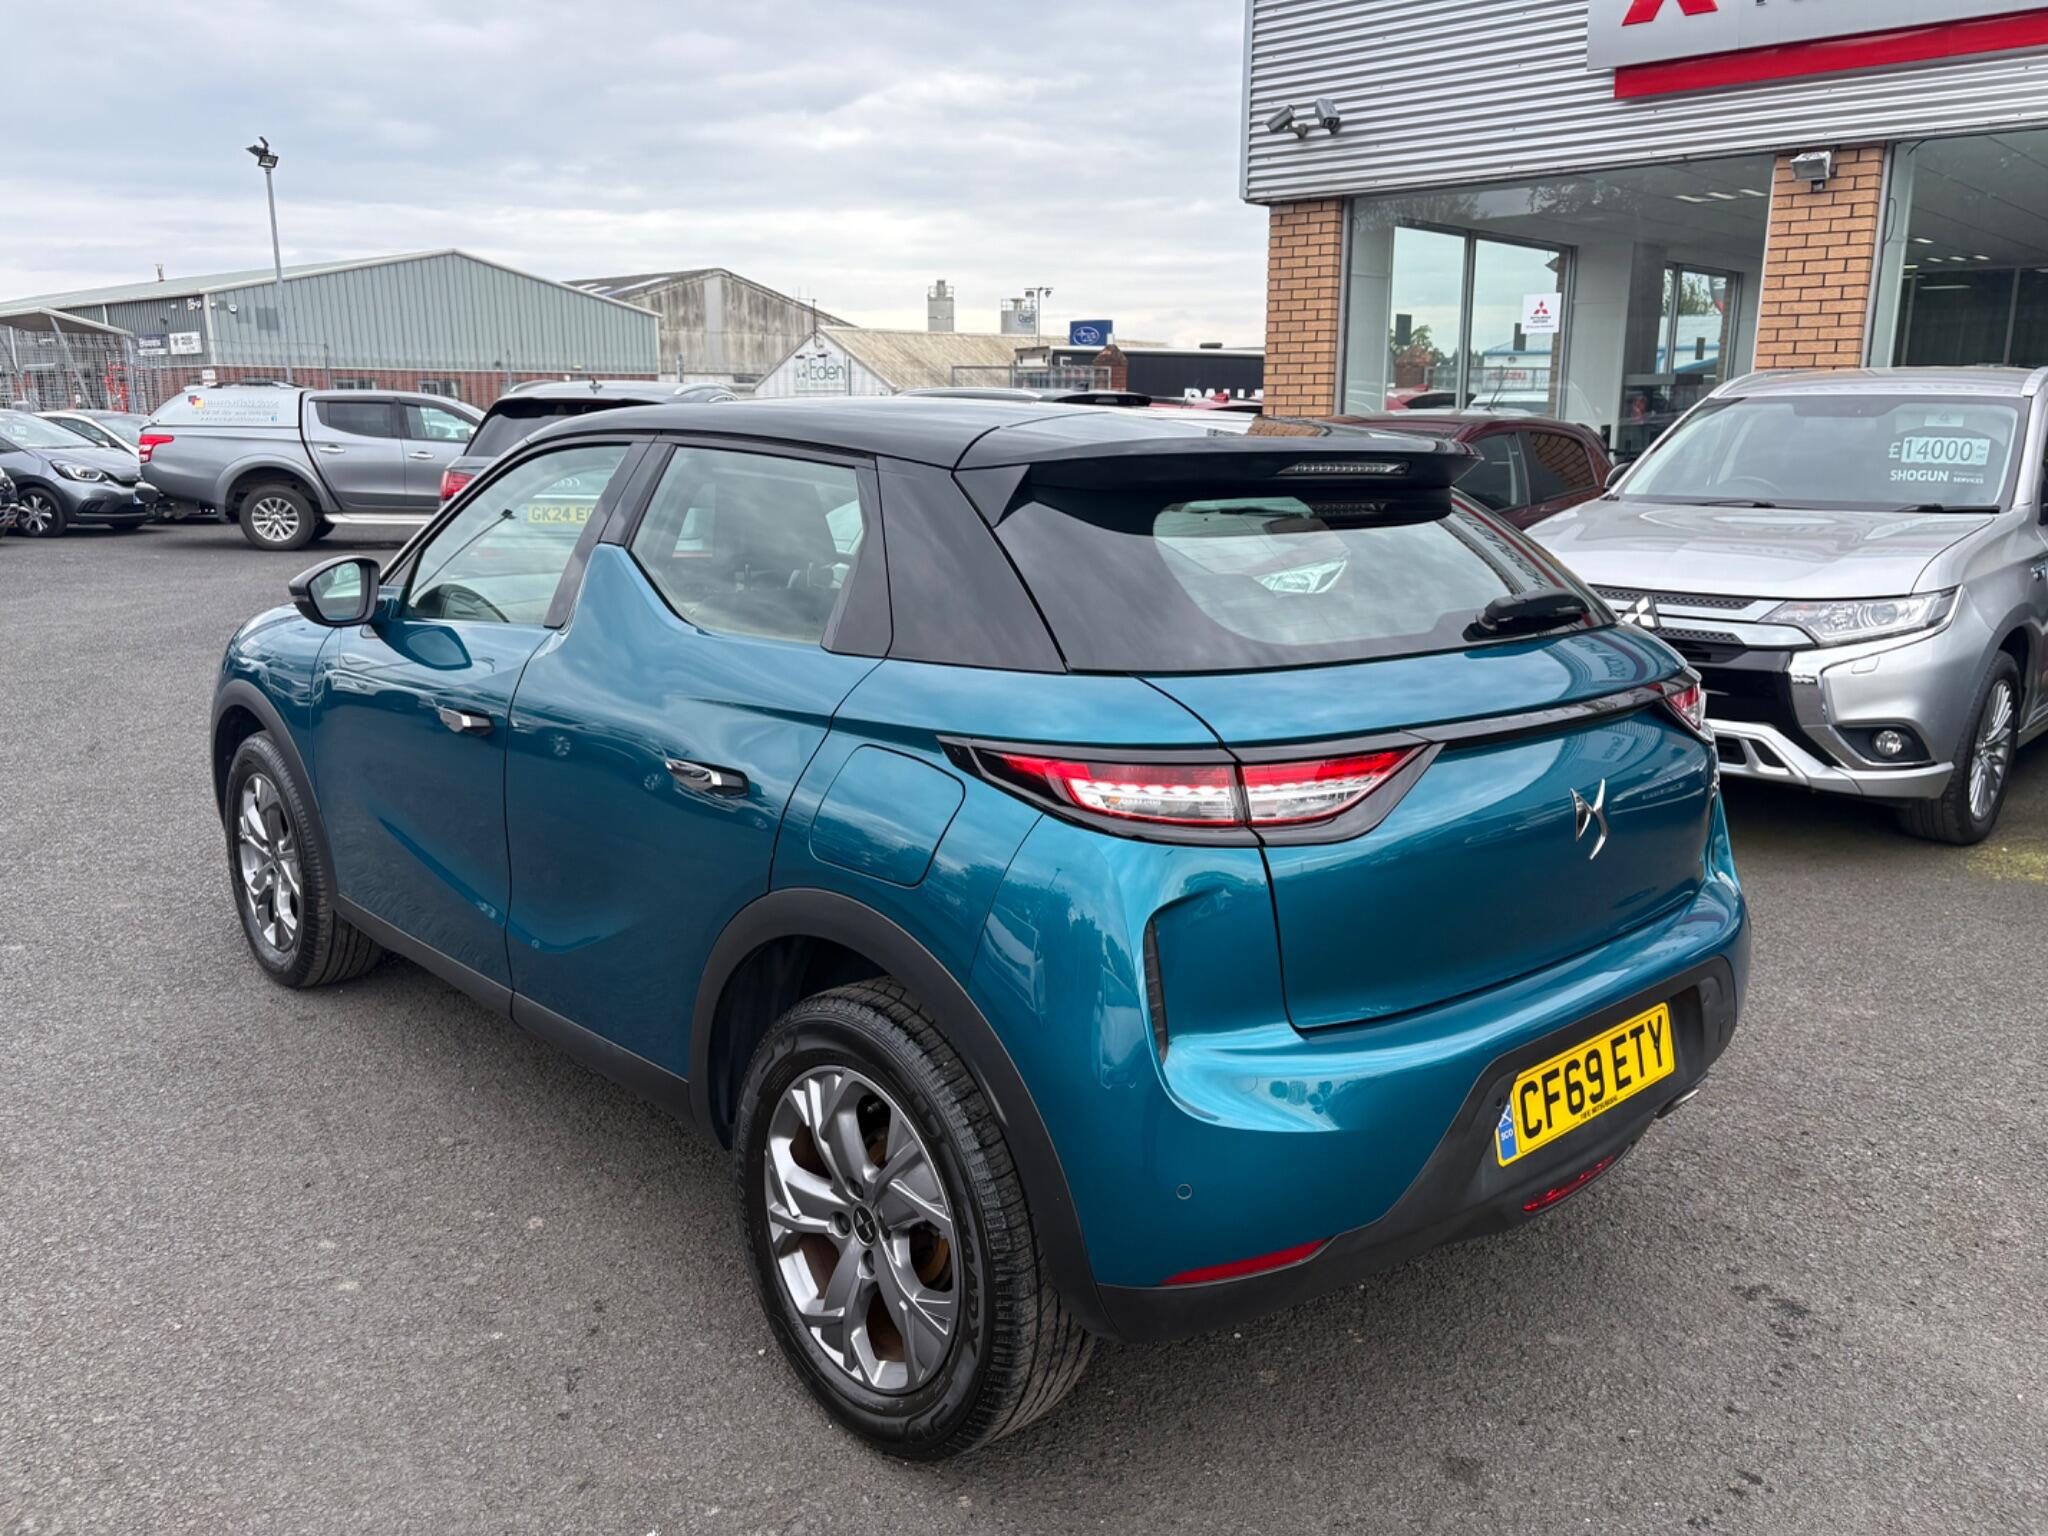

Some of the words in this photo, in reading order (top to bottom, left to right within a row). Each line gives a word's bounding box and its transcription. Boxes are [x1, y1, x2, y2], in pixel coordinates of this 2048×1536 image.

[809, 357, 845, 380] Eden
[1889, 469, 1949, 482] SHOGUN
[531, 506, 571, 521] GK24
[1519, 1048, 1606, 1140] CF69
[1610, 1015, 1663, 1092] ETY
[1500, 1129, 1514, 1141] SCO
